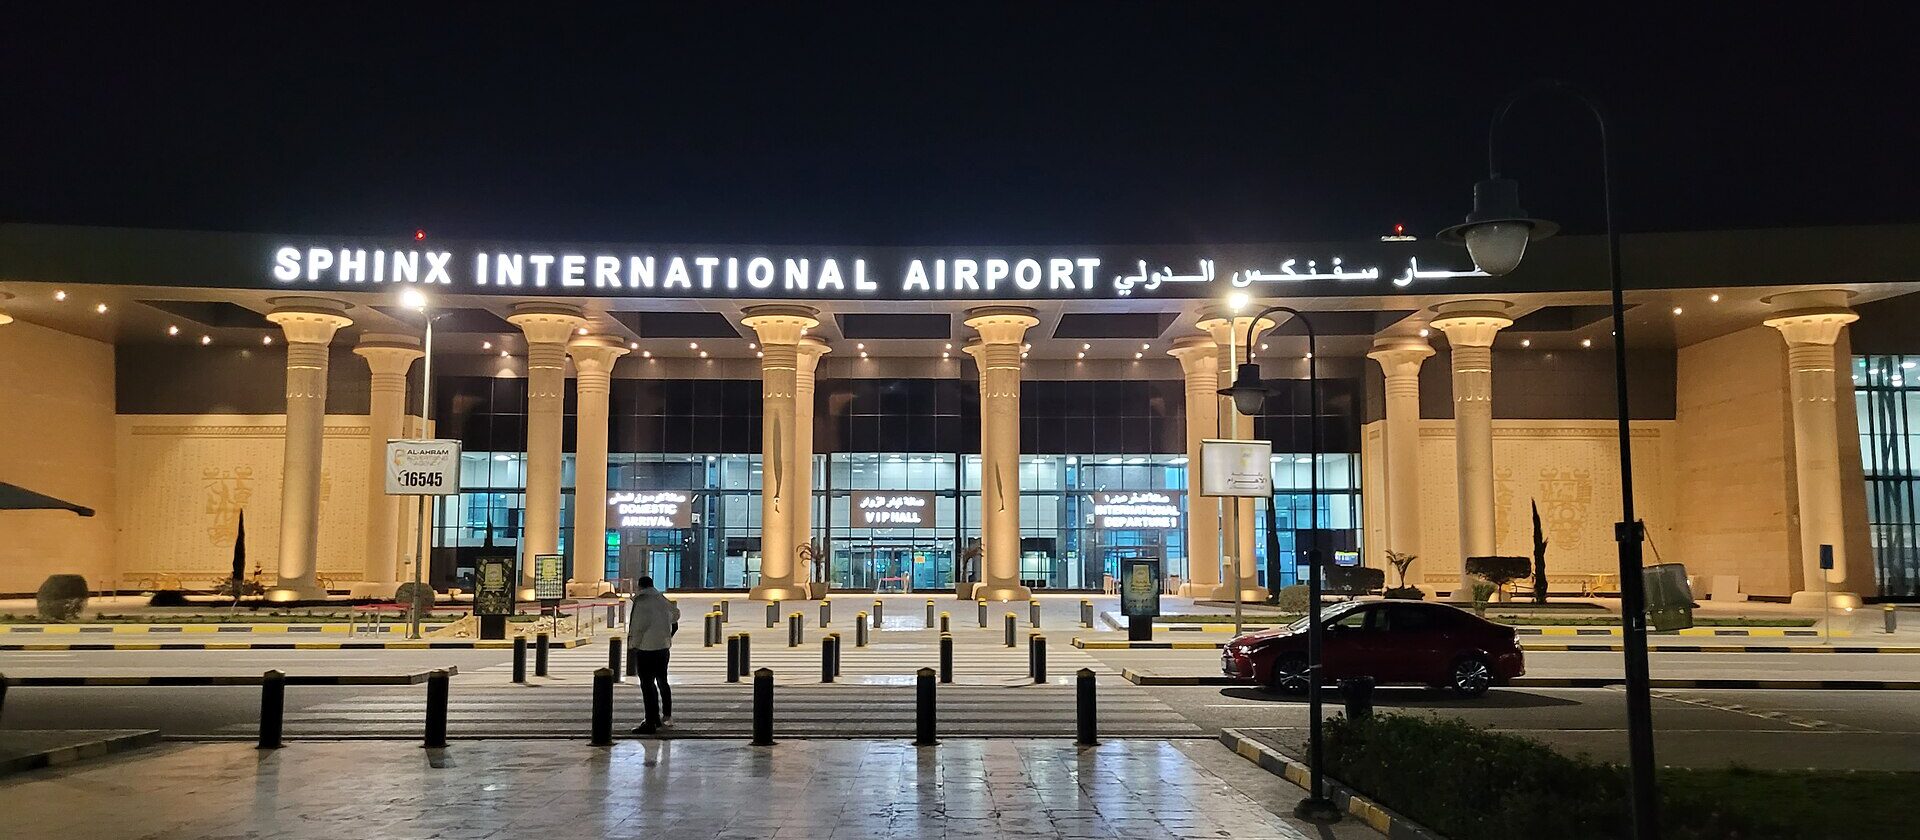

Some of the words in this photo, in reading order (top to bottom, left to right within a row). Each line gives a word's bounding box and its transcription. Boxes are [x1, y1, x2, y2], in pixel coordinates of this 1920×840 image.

[272, 246, 452, 285] SPHINX
[475, 252, 878, 292] INTERNATIONAL
[902, 258, 1101, 291] AIRPORT
[1232, 256, 1379, 288] سفنكس
[1393, 255, 1492, 287] ار
[404, 471, 442, 487] 16545
[618, 504, 677, 515] DOMESTIC
[1094, 504, 1180, 516] INTERNATIONAL
[621, 516, 674, 527] ARRIVAL
[865, 511, 890, 523] VIP
[890, 511, 922, 523] HALL
[1104, 516, 1170, 528] DEPARTURE
